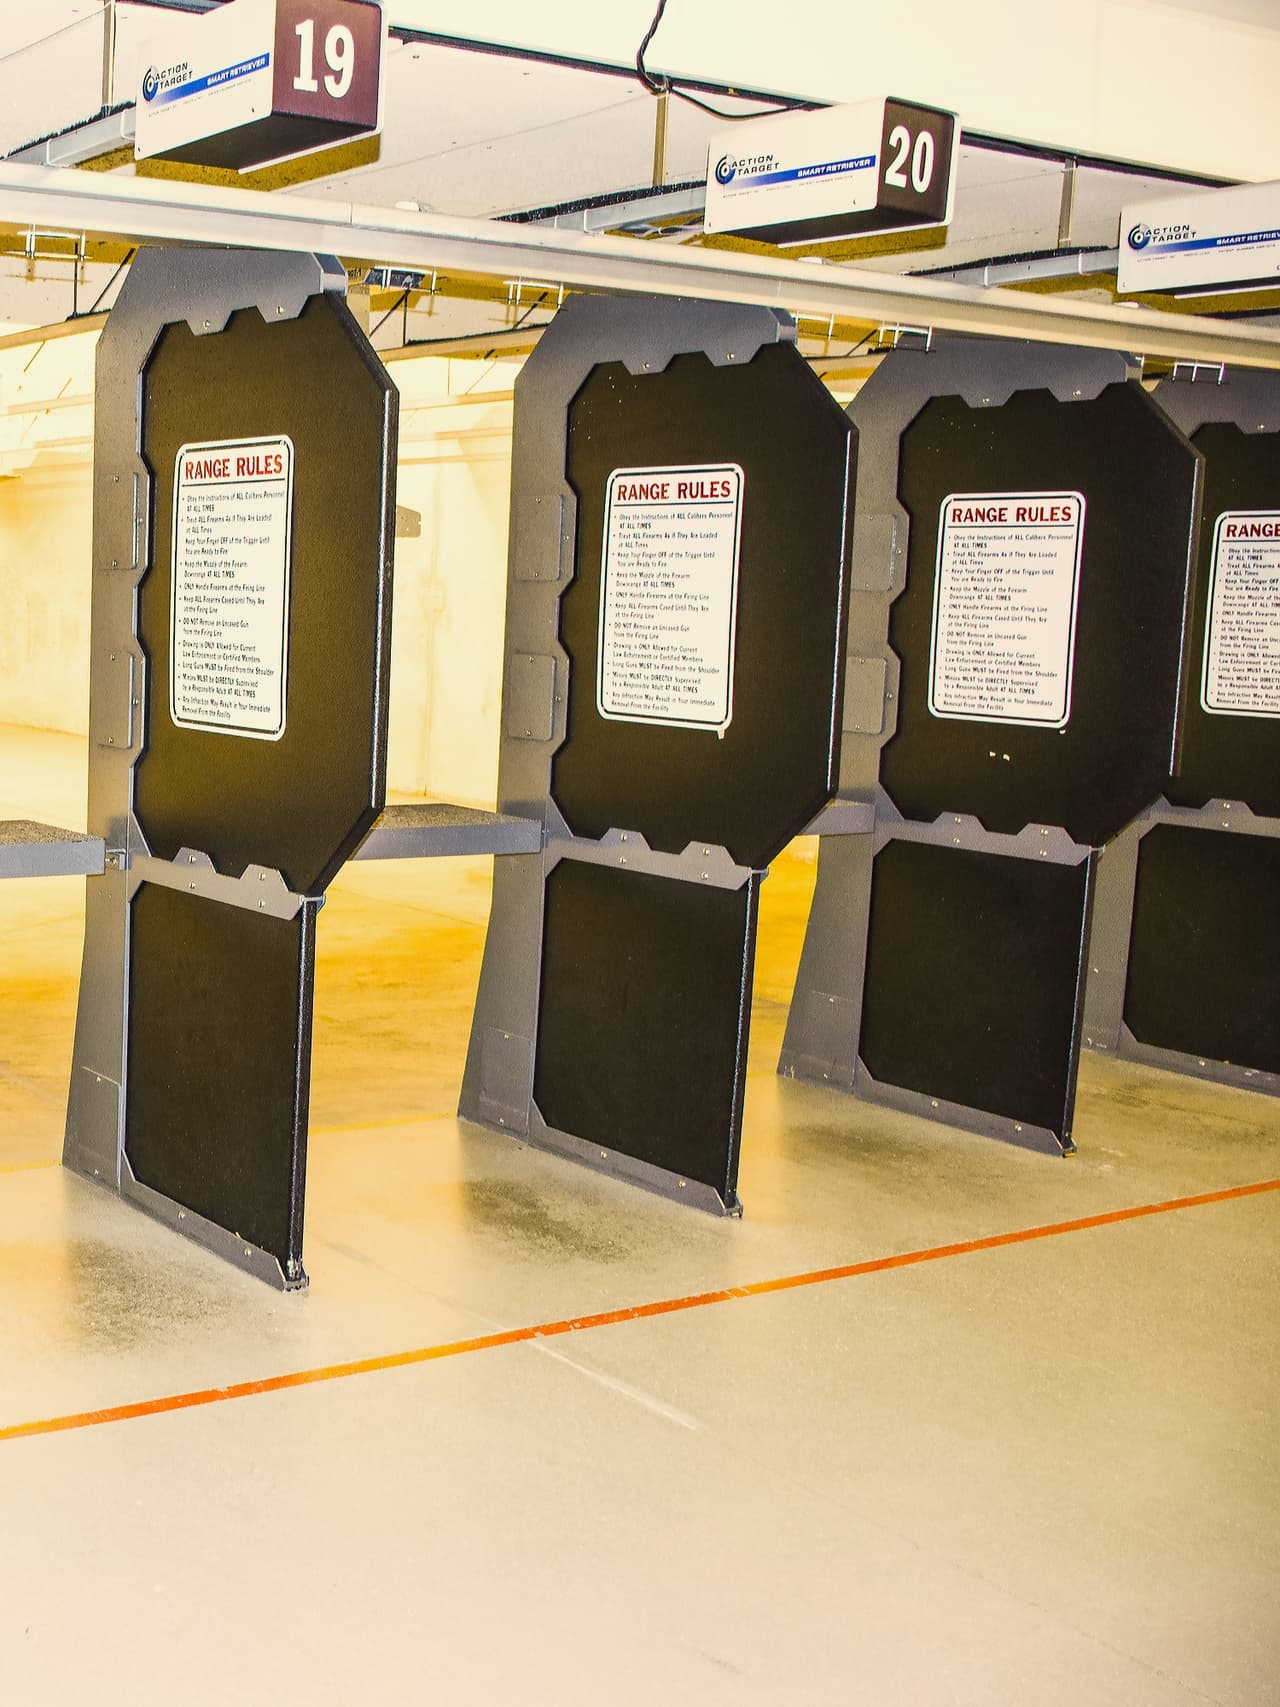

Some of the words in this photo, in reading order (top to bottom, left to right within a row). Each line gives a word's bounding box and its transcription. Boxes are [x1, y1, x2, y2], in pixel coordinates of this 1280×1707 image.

[293, 19, 354, 98] 19
[154, 61, 189, 81] ACTION
[159, 70, 193, 90] TARGET
[206, 70, 231, 86] SMART
[230, 58, 266, 80] RETRIEVER
[731, 154, 774, 169] ACTION
[737, 162, 780, 176] TARGET
[798, 166, 826, 178] SMART
[826, 158, 871, 173] RETRIEVER
[884, 125, 935, 193] 20
[1146, 224, 1190, 236] ACTION
[1152, 232, 1198, 243] TARGET
[1216, 236, 1246, 246] SMART
[185, 458, 230, 480] RANGE
[236, 454, 283, 477] RULES
[617, 482, 670, 501] RANGE
[678, 480, 731, 500] RULES
[952, 507, 1008, 523] RANGE
[1016, 506, 1072, 522] RULES
[1226, 524, 1280, 538] RANGE
